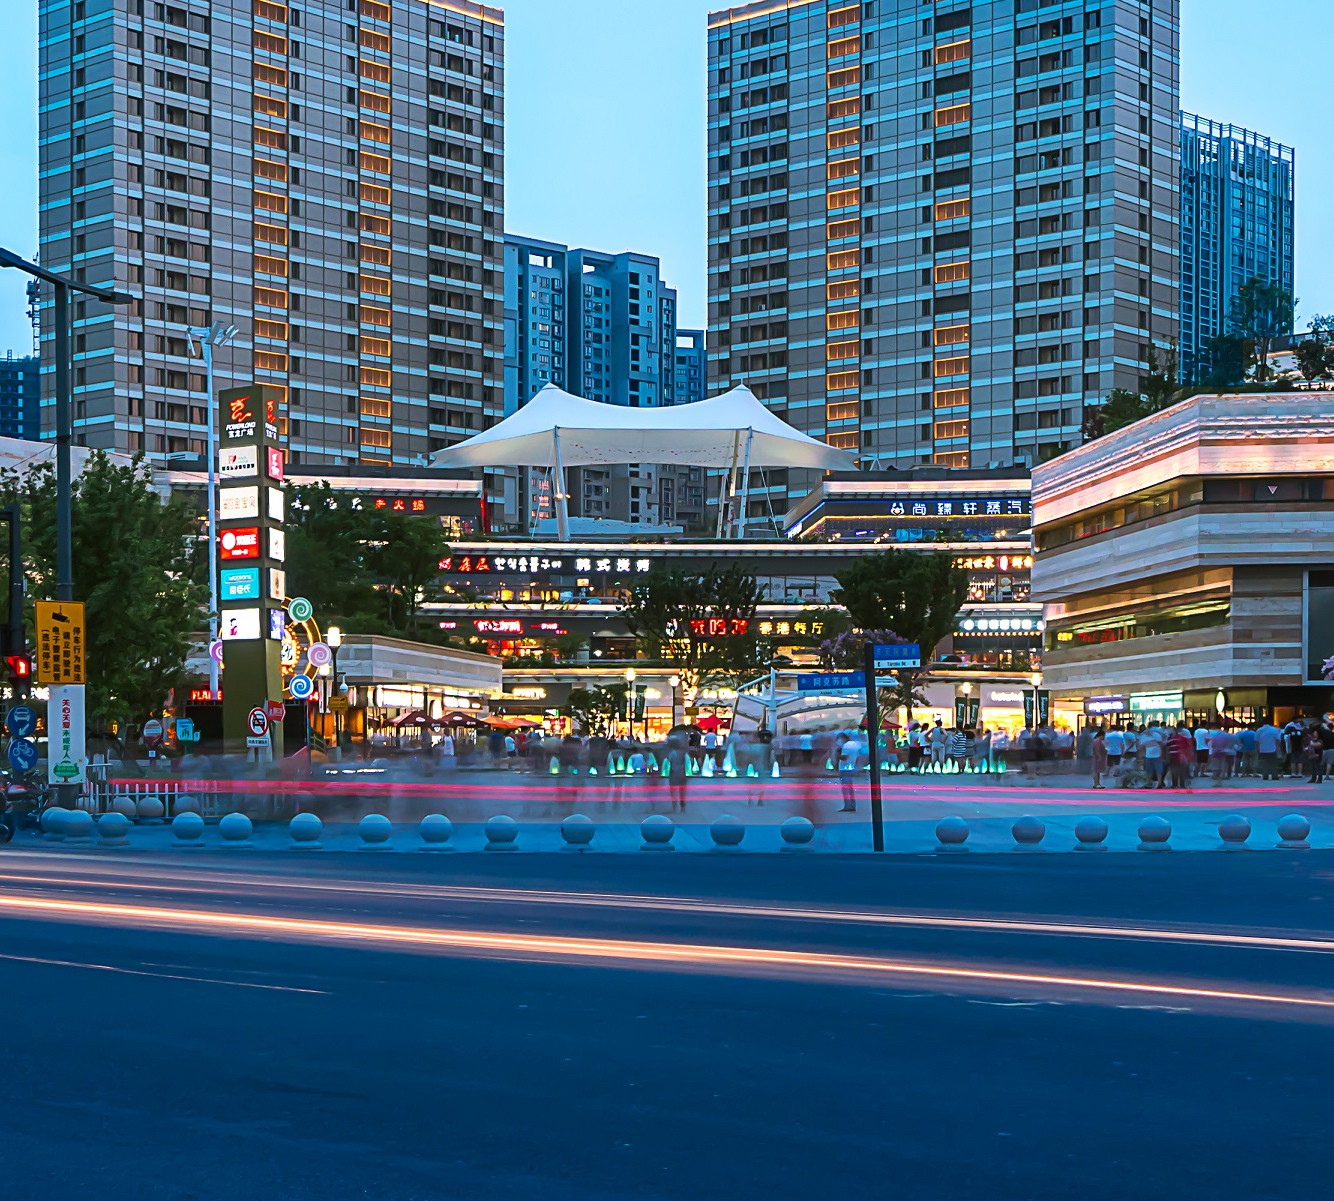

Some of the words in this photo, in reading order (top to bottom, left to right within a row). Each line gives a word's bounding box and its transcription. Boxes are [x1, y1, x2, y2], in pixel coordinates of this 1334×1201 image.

[912, 500, 1032, 516] 尚臻轩蒸汽
[814, 676, 849, 687] 阿克苏路
